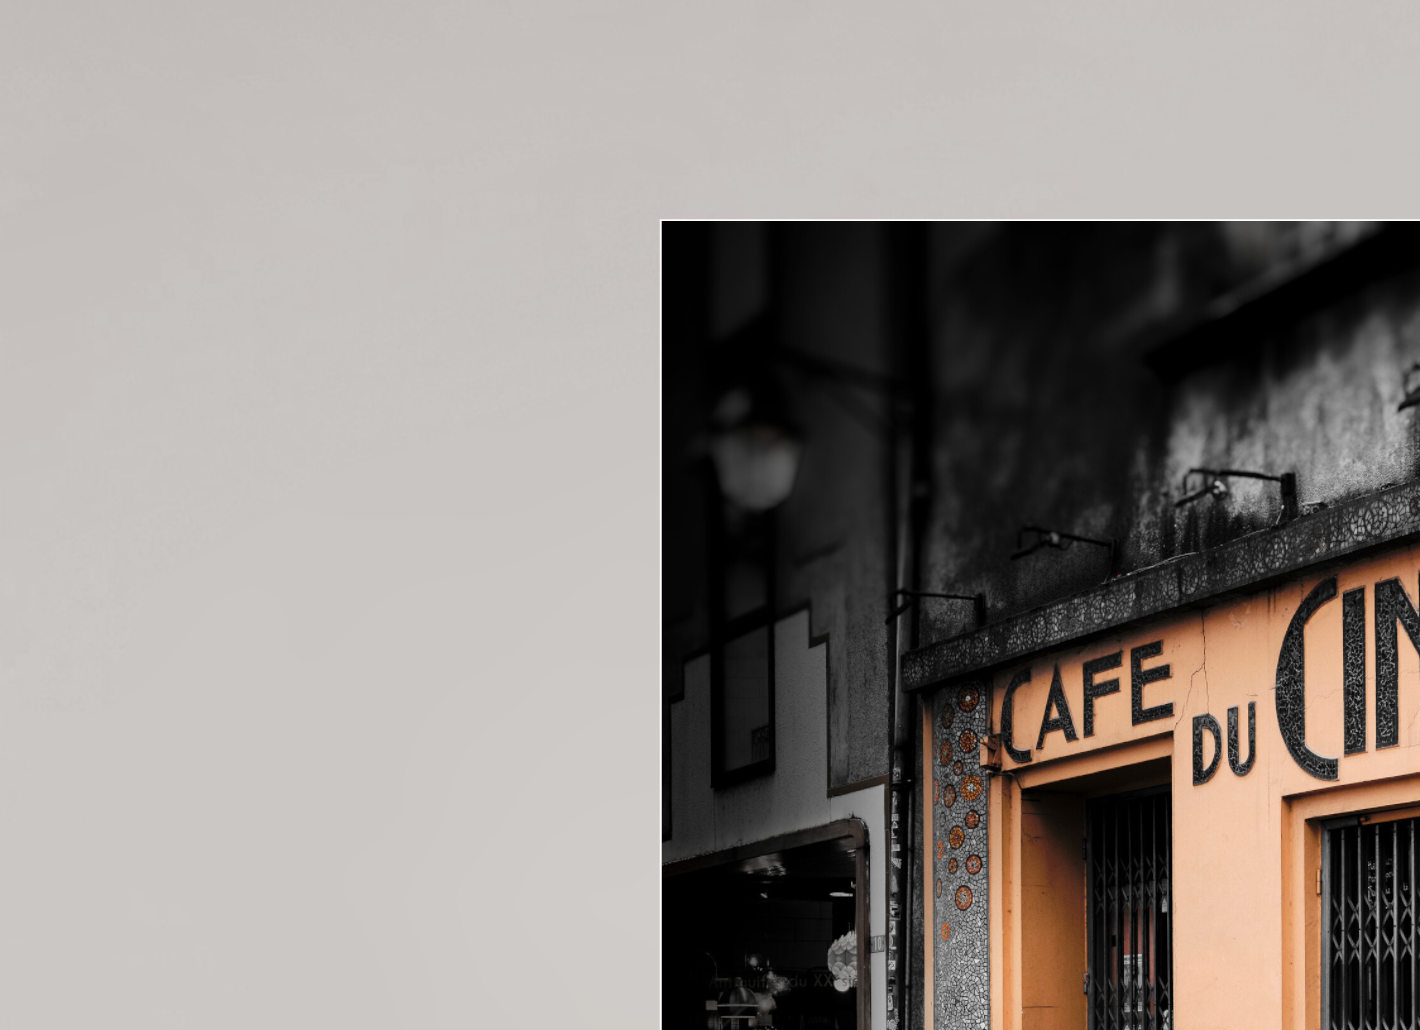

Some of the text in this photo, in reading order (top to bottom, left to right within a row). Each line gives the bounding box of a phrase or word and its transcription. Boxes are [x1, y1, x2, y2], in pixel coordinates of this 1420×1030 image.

[1000, 640, 1175, 763] CAFE
[1192, 701, 1257, 786] DU
[874, 936, 882, 951] 10
